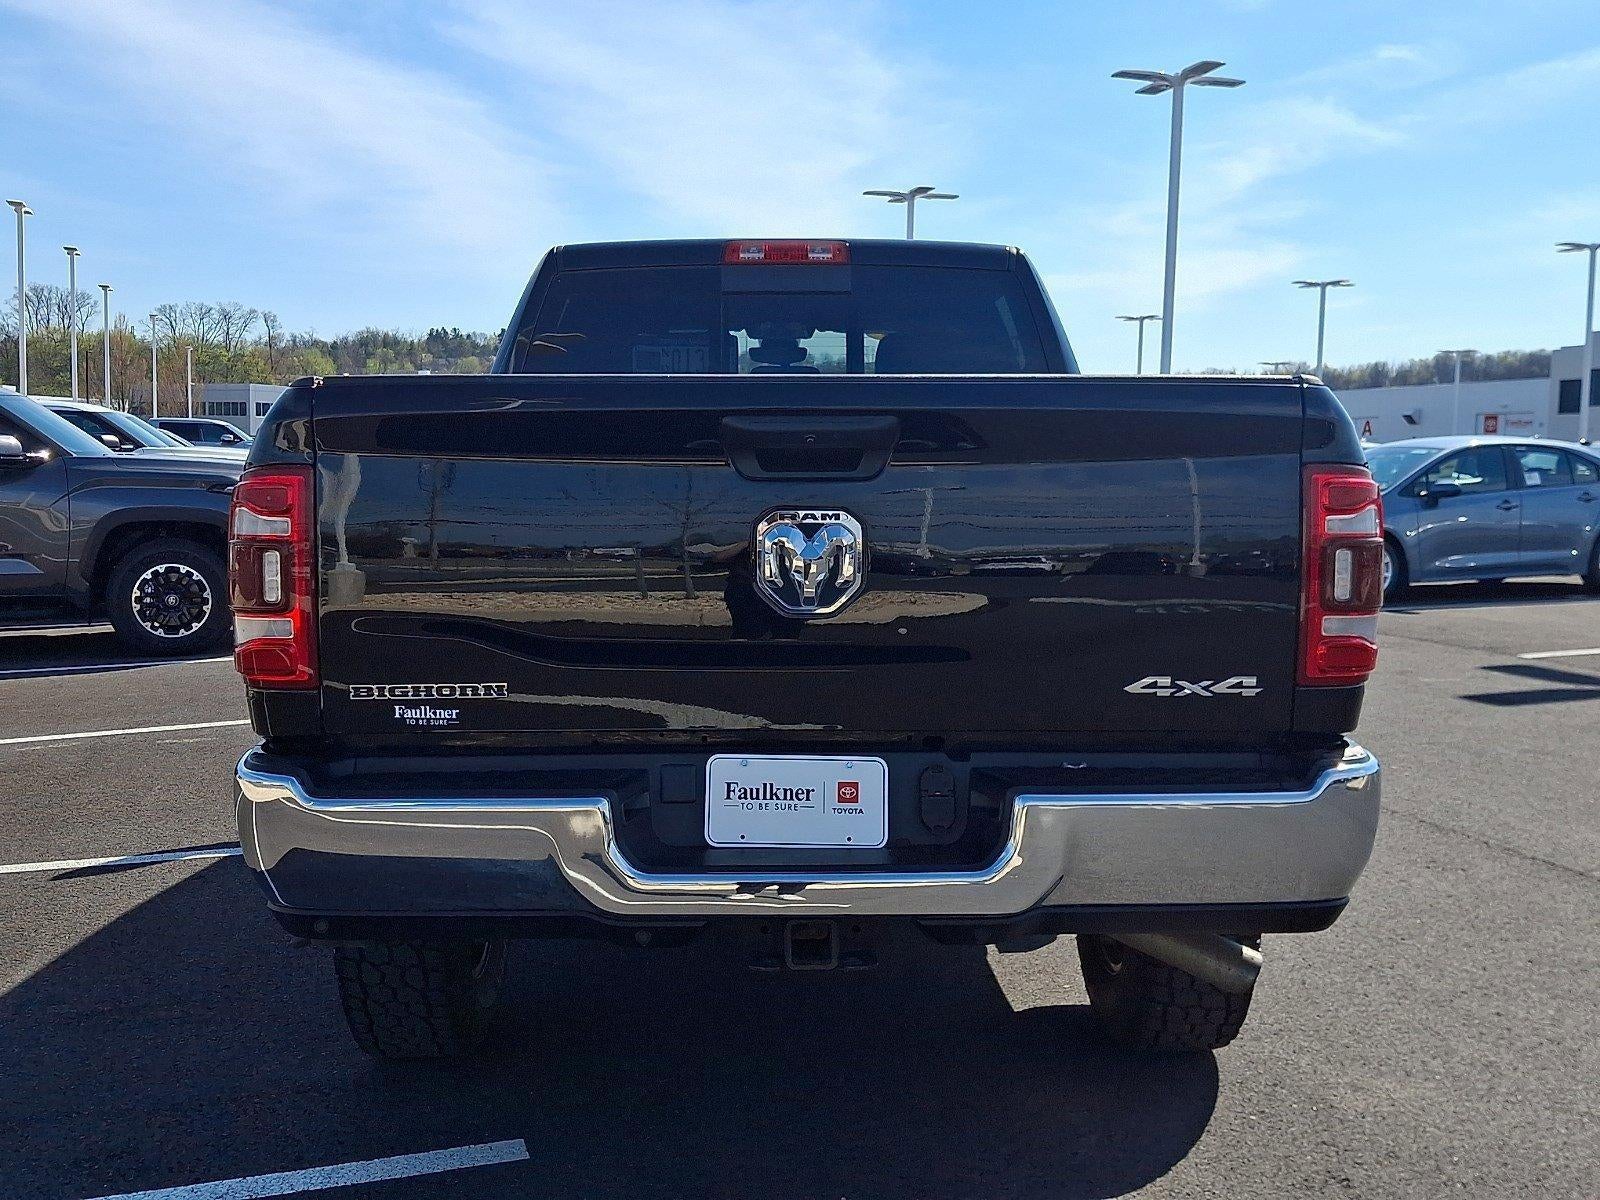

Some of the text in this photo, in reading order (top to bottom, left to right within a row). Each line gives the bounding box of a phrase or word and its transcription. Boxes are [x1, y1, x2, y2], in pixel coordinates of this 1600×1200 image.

[778, 512, 841, 521] RAM
[350, 683, 508, 700] BIGHORN
[394, 705, 460, 718] Faulkner
[724, 781, 816, 801] Faulkner
[740, 802, 799, 811] TO BE SURE
[831, 807, 864, 815] TOYOTA
